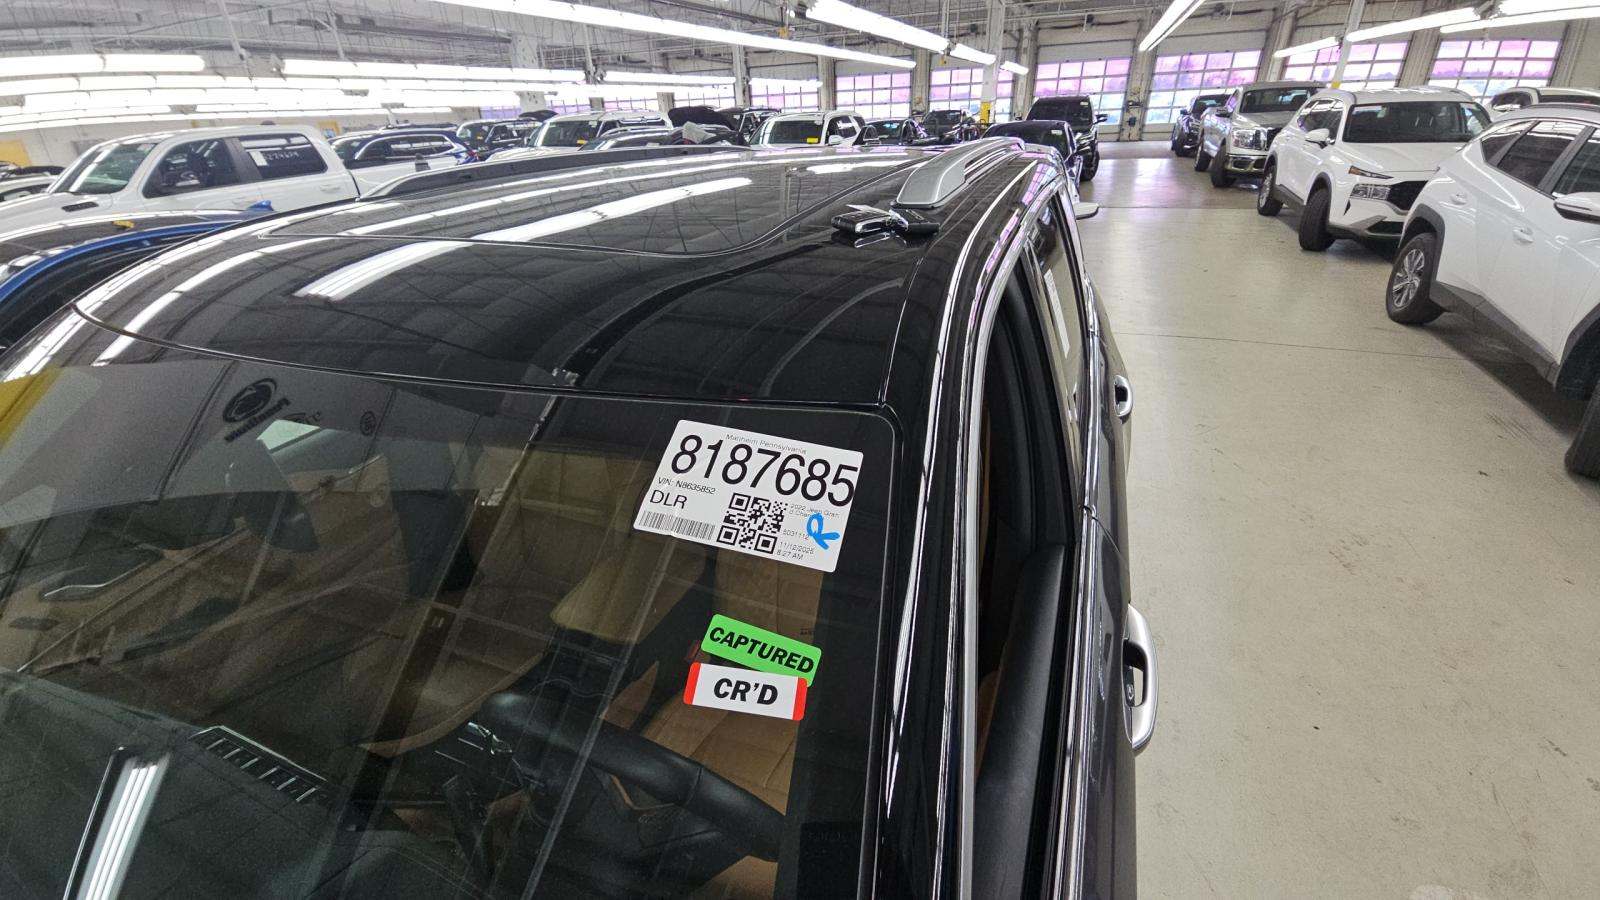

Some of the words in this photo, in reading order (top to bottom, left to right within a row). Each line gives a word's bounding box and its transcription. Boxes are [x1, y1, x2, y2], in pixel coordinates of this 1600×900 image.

[760, 440, 807, 455] Pennsylvania
[671, 434, 858, 507] 8187685
[658, 477, 674, 486] VIN:
[675, 480, 716, 495] N8635852
[650, 489, 688, 509] DLR
[709, 627, 814, 673] CAPTURED
[713, 678, 778, 705] CR'D
